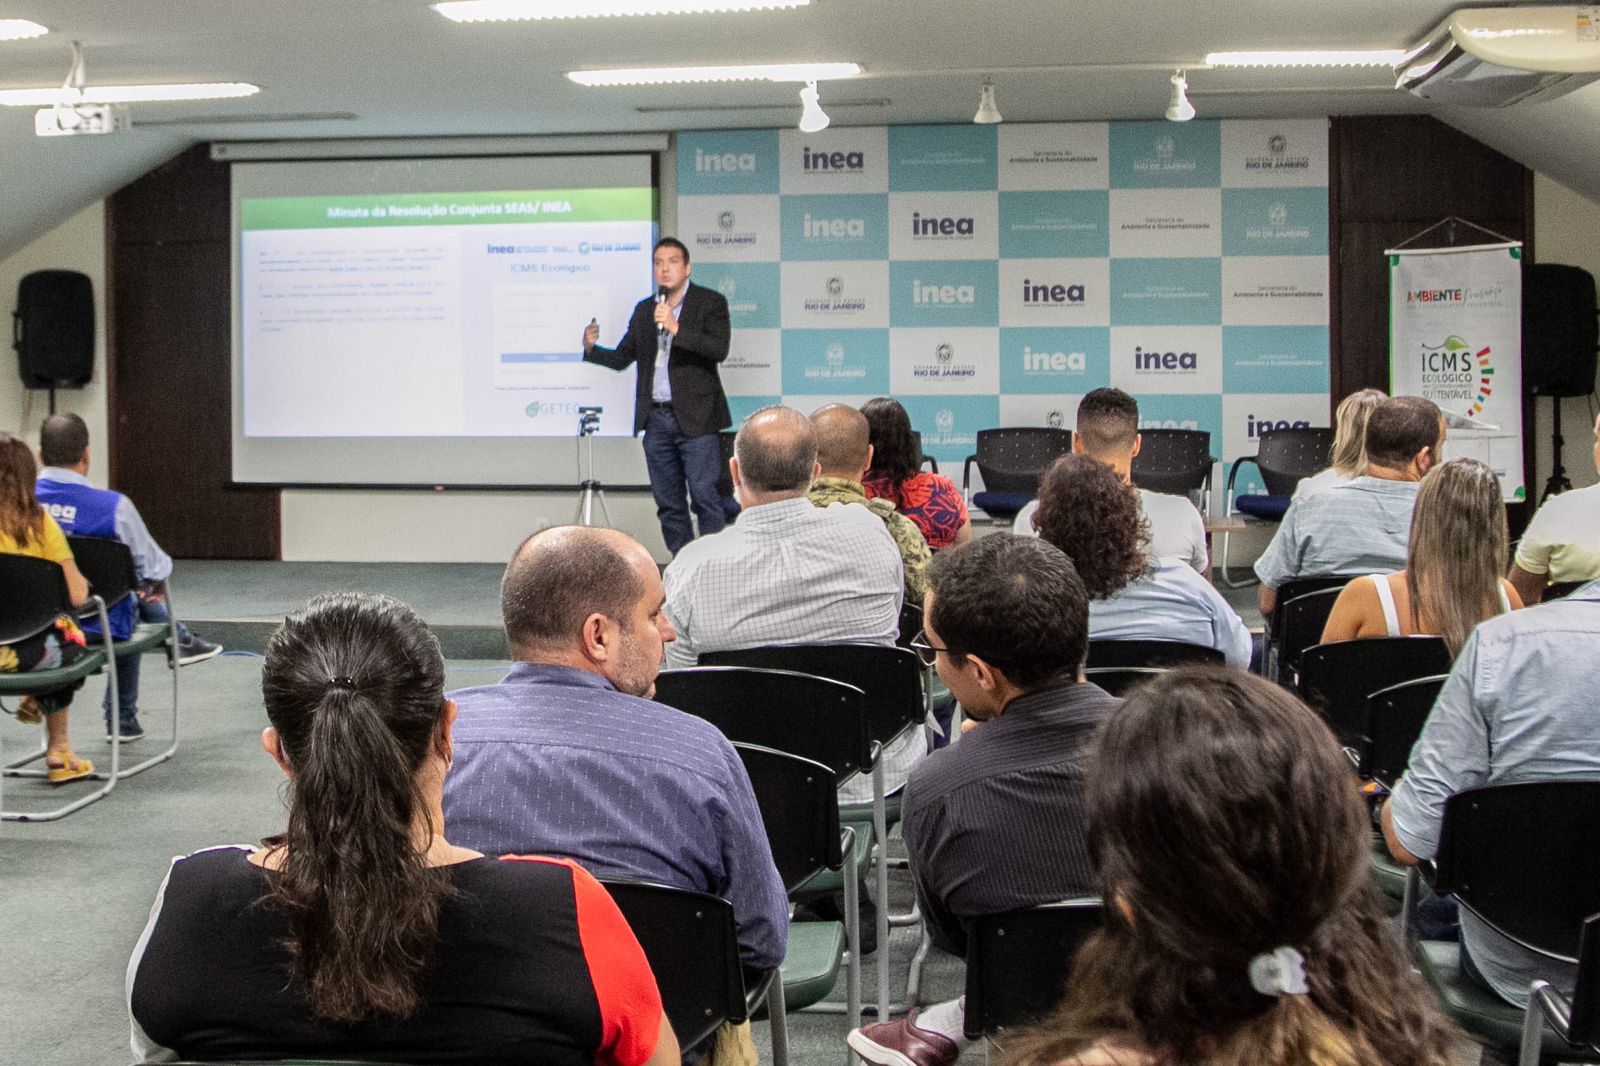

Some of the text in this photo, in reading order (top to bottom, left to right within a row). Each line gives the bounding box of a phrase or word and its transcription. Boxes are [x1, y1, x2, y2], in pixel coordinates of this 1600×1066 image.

[695, 148, 756, 173] inea
[803, 146, 864, 169] inea
[327, 207, 369, 219] Minuta
[372, 206, 386, 217] da
[389, 204, 447, 218] Resolução
[505, 202, 540, 215] SEAS/
[542, 201, 572, 213] INEA
[803, 213, 865, 238] inea
[913, 212, 974, 235] inea
[487, 243, 515, 254] inea
[511, 263, 591, 275] ICMS Ecológico
[913, 280, 975, 305] inea
[1024, 279, 1085, 302] inea
[1407, 289, 1462, 304] AMBIENTE
[1024, 347, 1086, 371] inea
[1135, 346, 1197, 370] inea
[1422, 352, 1472, 372] ICMS
[914, 369, 975, 377] RIO DE JANEIRO
[1422, 371, 1473, 383] ECOLÓGICO
[1422, 388, 1474, 400] SUSTENTÁVEL
